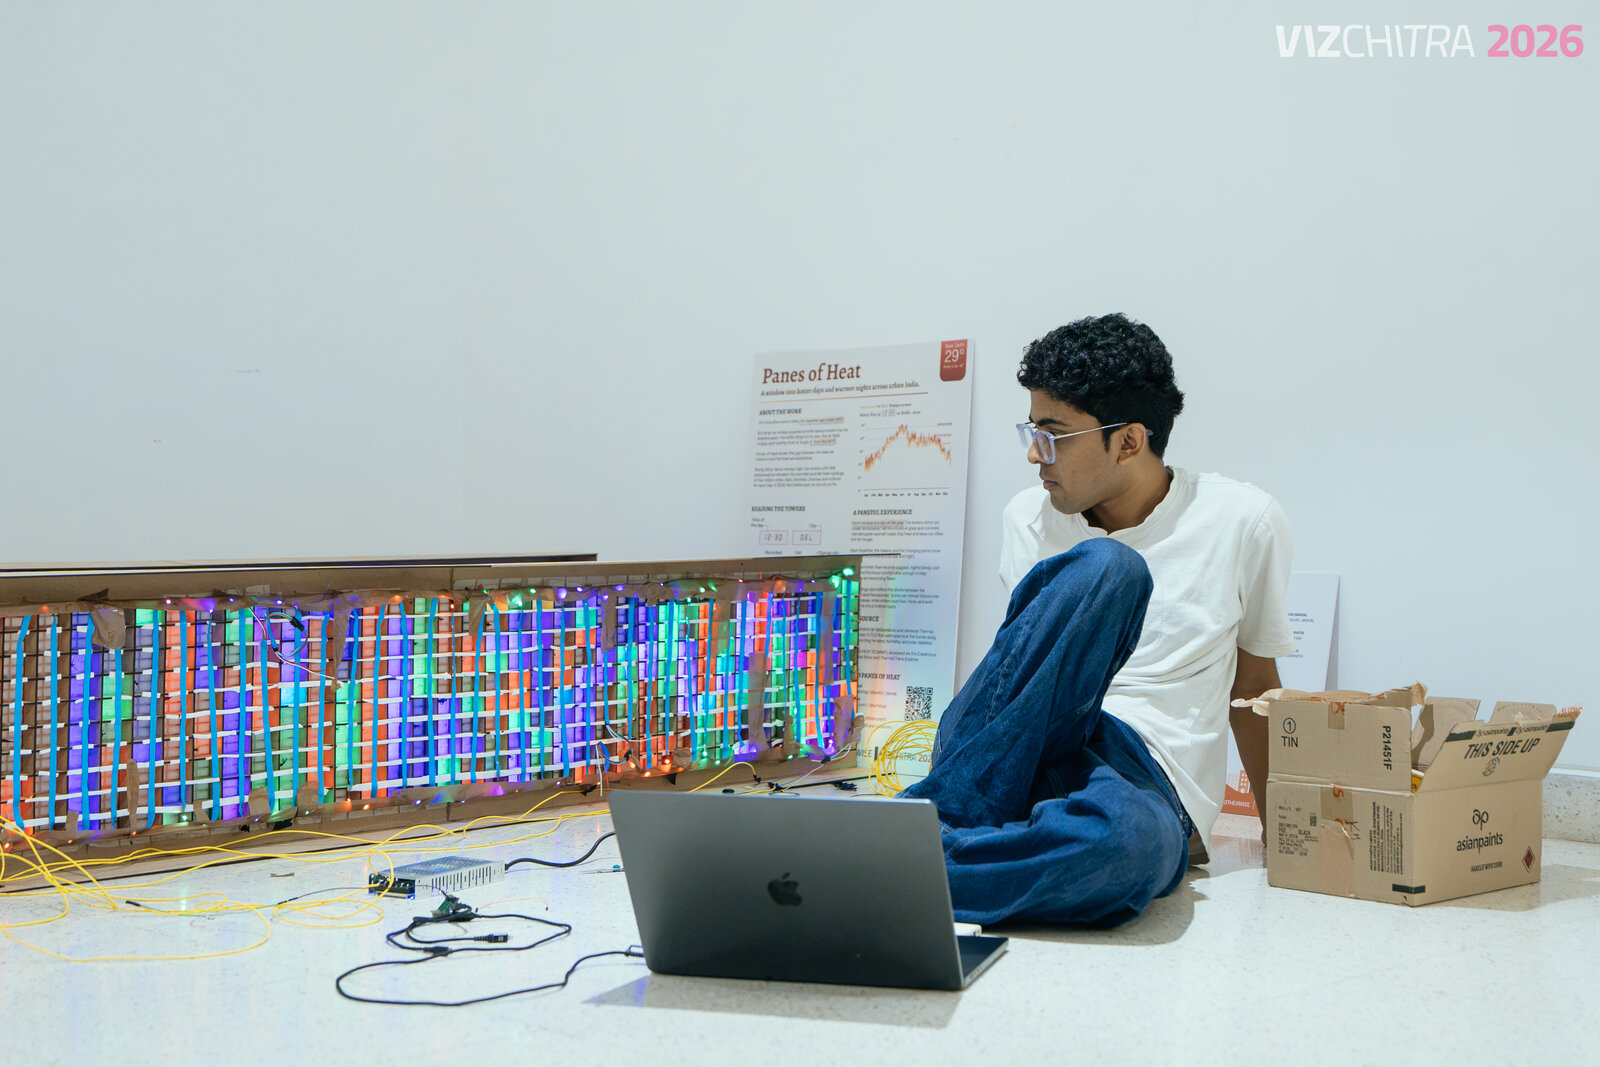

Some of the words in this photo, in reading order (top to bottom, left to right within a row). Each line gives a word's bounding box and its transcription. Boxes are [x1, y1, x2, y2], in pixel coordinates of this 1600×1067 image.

[763, 367, 805, 384] Panes
[808, 362, 826, 381] of
[826, 363, 861, 379] Heat
[1281, 735, 1299, 748] TIN
[1382, 725, 1393, 770] P21451F
[1464, 742, 1493, 759] THIS
[1492, 740, 1522, 756] SIDE
[1520, 737, 1541, 753] UP
[917, 753, 933, 763] 202
[1456, 832, 1503, 855] asianpaints
